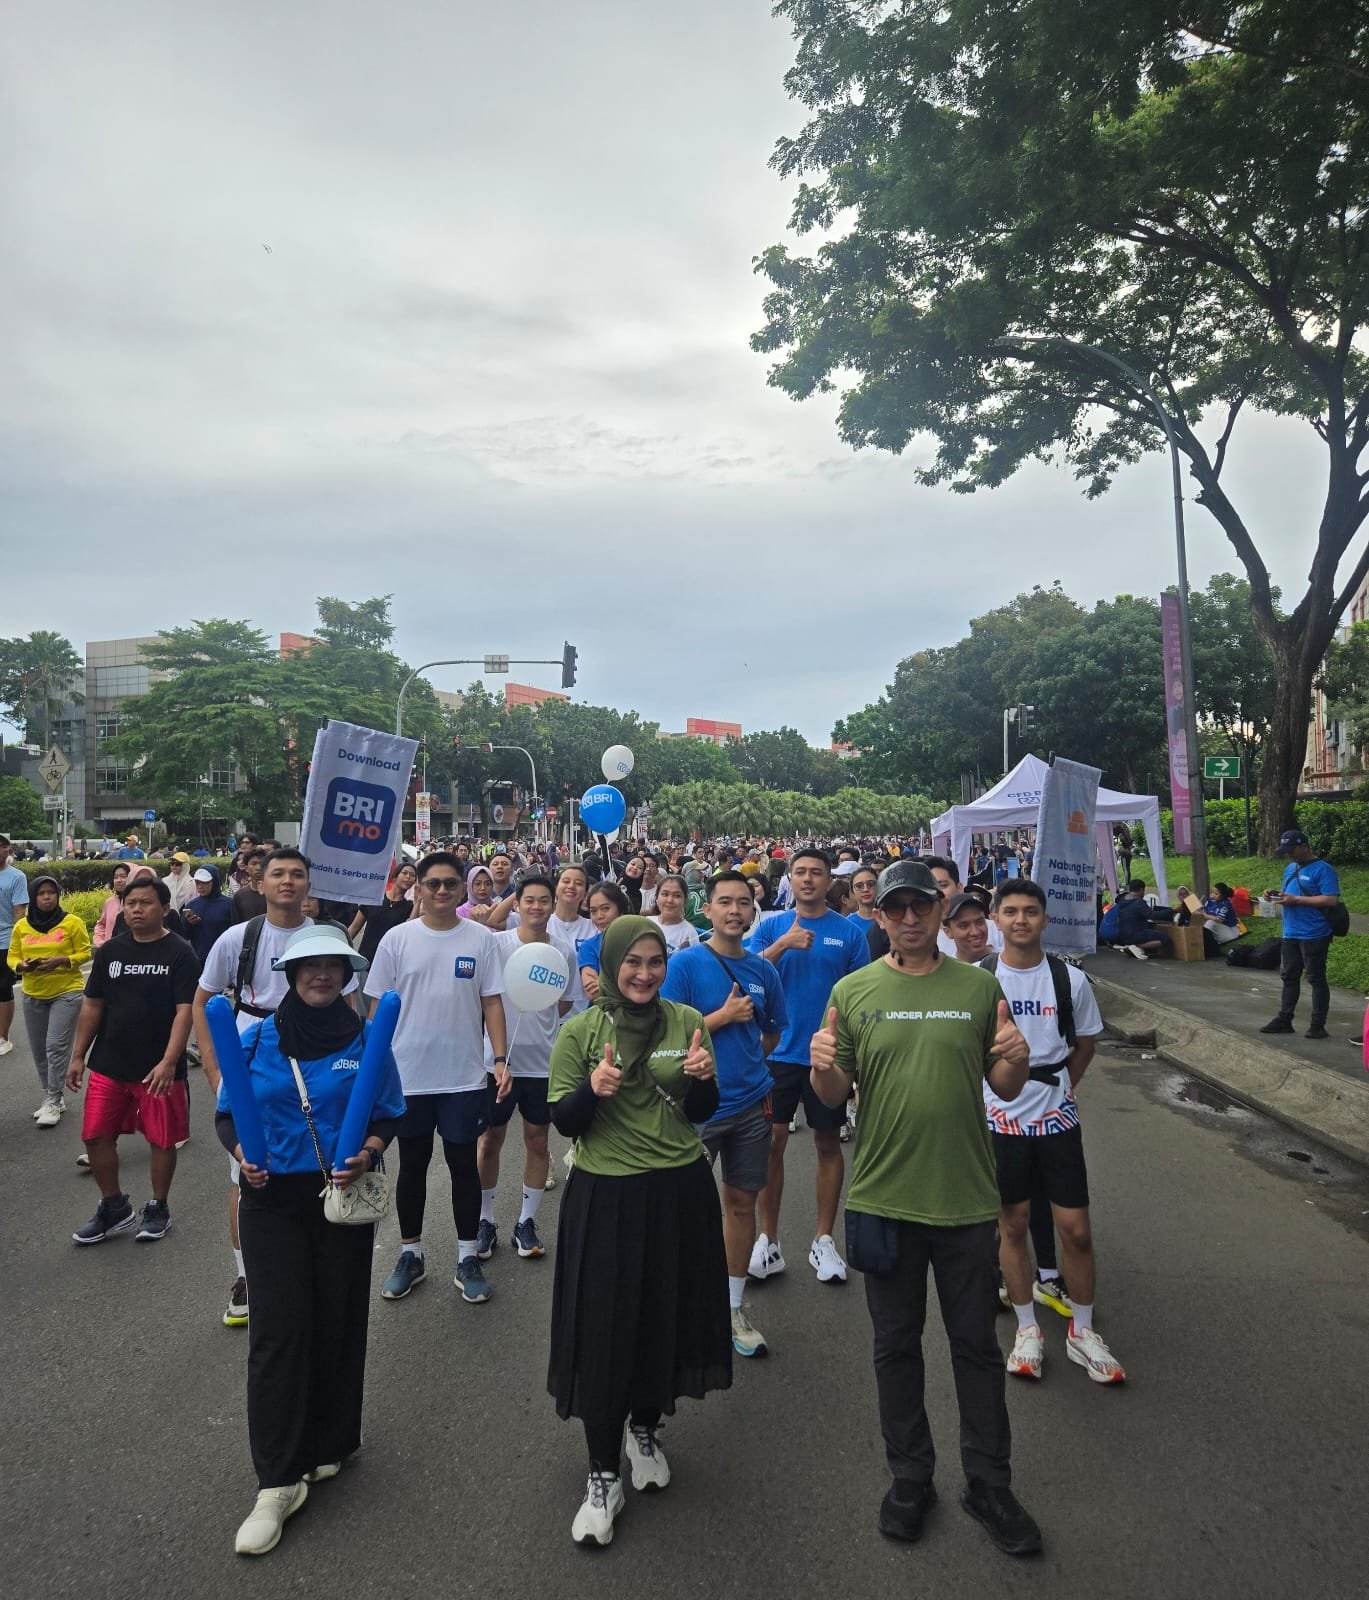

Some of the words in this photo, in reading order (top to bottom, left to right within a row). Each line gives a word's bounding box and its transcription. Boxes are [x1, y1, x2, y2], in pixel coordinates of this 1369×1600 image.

[338, 748, 401, 772] Download
[593, 793, 613, 804] BRI
[333, 791, 385, 825] BRI
[337, 818, 382, 841] mo
[334, 867, 341, 875] &
[342, 868, 368, 879] Serba
[369, 872, 386, 881] Bisa
[1053, 874, 1078, 887] Bebas
[1048, 888, 1075, 901] Pakai
[123, 964, 170, 976] SENTUH
[458, 960, 474, 970] BRI
[547, 971, 567, 990] BRI
[886, 1011, 923, 1020] UNDER
[925, 1010, 972, 1021] ARMOUR
[650, 1048, 689, 1059] ARMOUR
